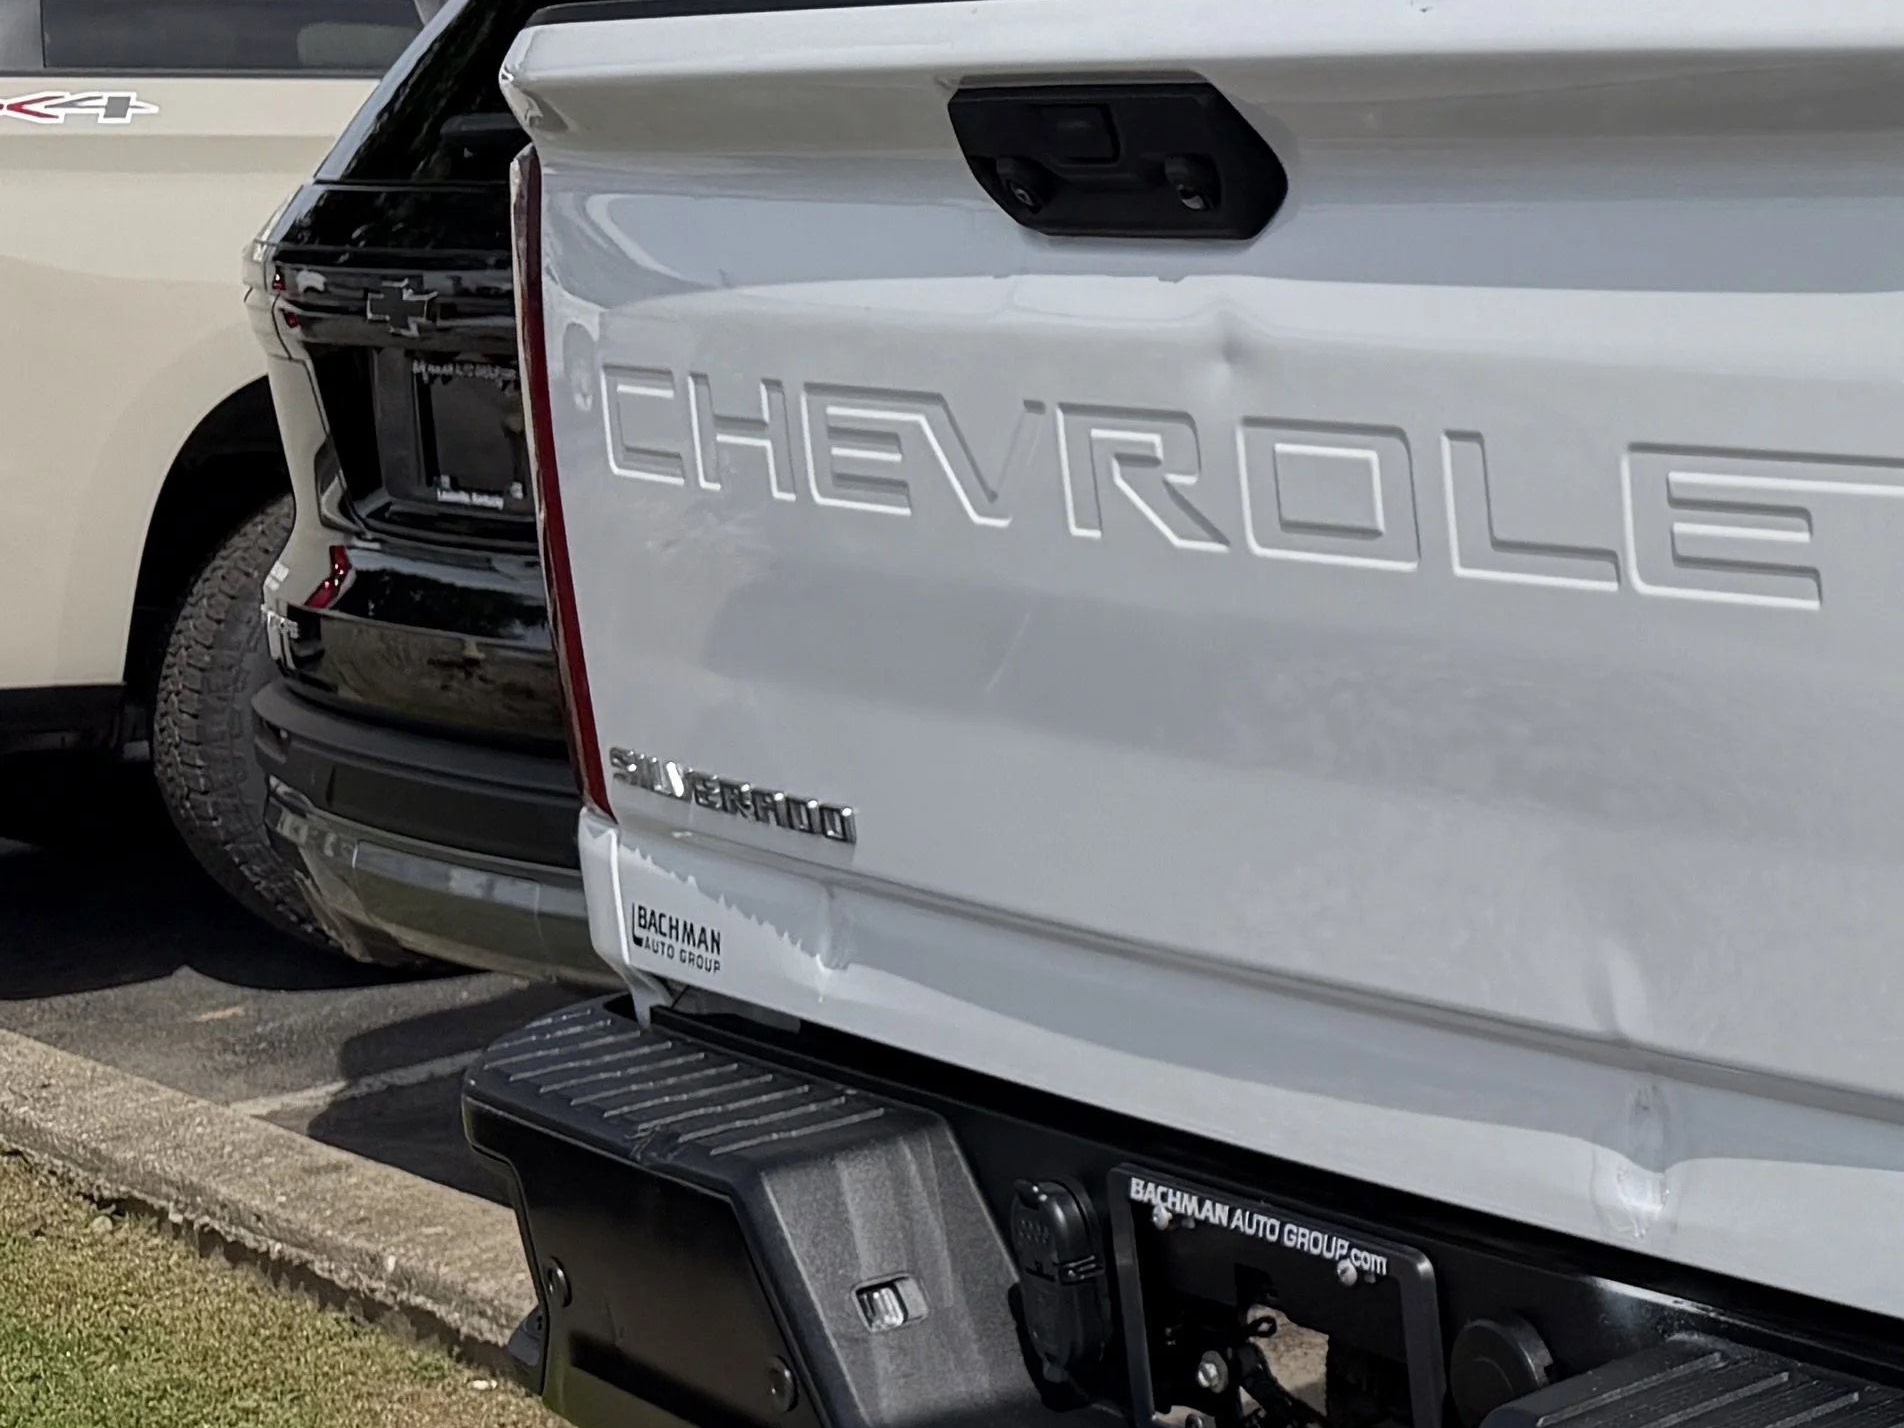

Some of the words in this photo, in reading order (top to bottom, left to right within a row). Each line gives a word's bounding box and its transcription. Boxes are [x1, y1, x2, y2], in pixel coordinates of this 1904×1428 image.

[609, 746, 857, 844] SILVERADO
[638, 904, 721, 955] BACHMAN
[644, 935, 675, 960] AUTO
[679, 948, 721, 975] GROUP
[1130, 1176, 1230, 1227] BACHMAN
[1230, 1209, 1280, 1242] AUTO
